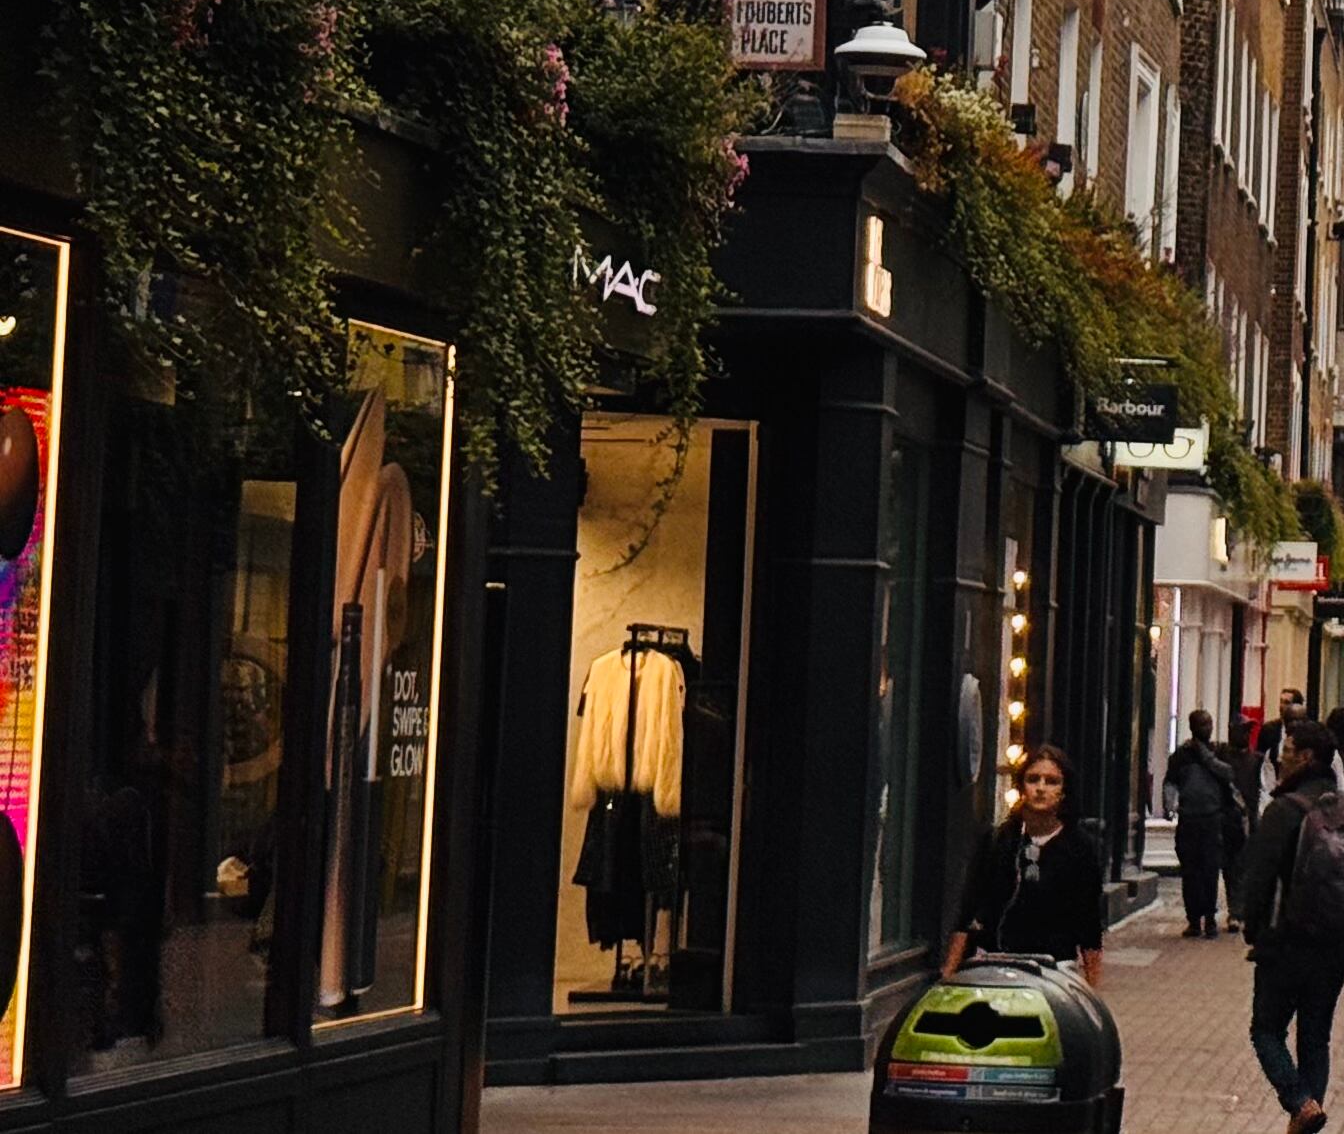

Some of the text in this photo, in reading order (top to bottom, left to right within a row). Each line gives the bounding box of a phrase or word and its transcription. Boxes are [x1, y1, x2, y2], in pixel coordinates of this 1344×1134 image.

[741, 28, 789, 55] PLACE
[573, 244, 662, 317] MAC
[394, 671, 419, 704] DOT,
[392, 706, 422, 738] SWIPE
[390, 745, 424, 777] GLOW
